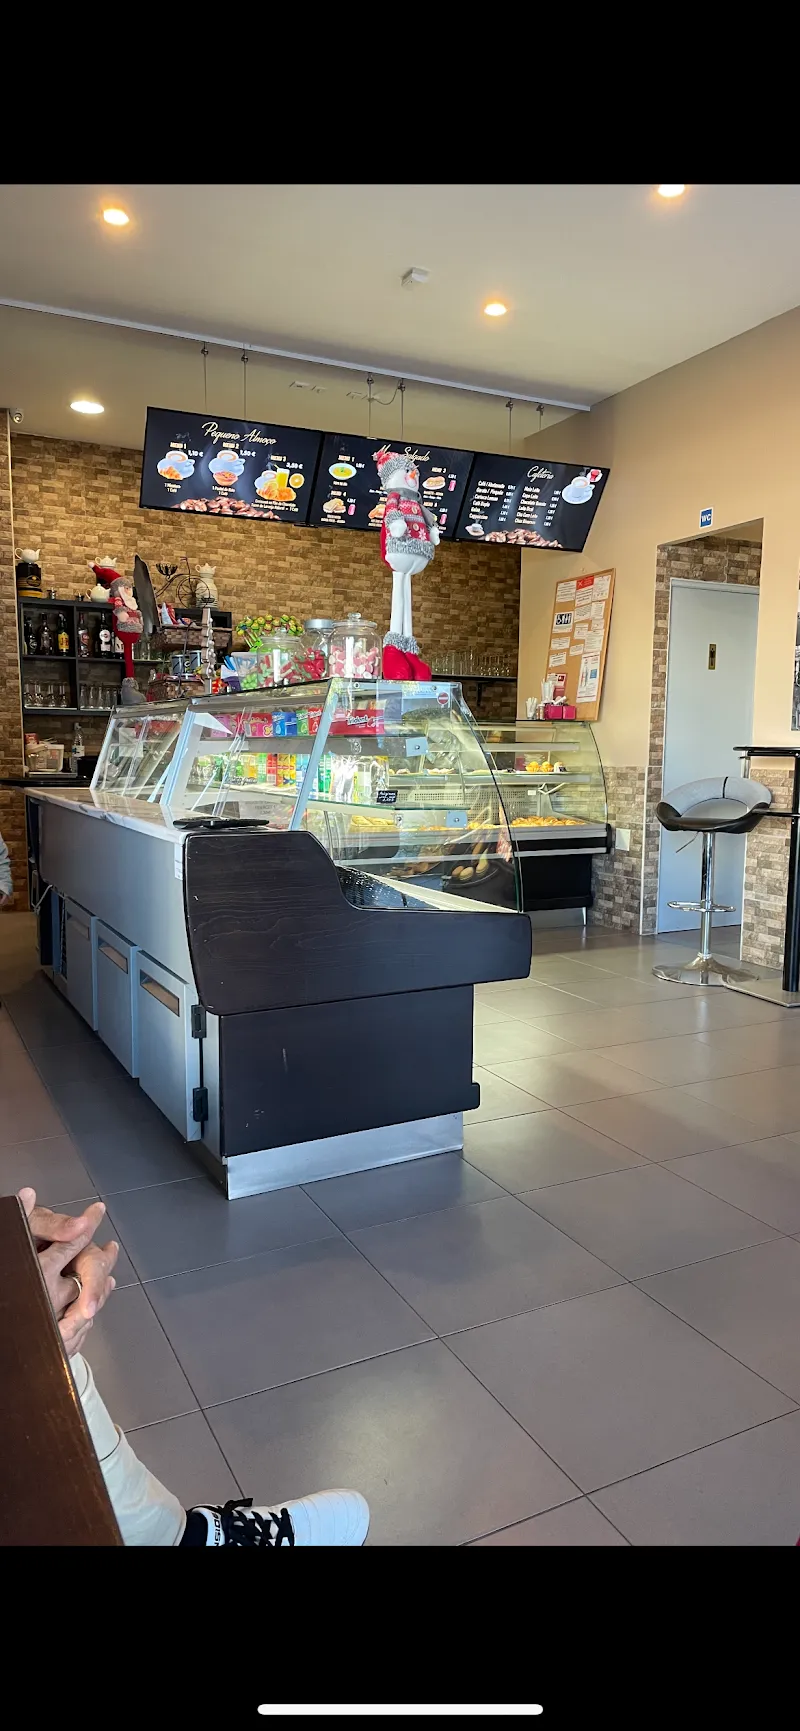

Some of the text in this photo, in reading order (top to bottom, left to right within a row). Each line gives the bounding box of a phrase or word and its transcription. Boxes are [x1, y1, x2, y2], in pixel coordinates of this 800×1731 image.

[202, 422, 277, 446] Pequeno Almoço
[702, 514, 711, 522] WC
